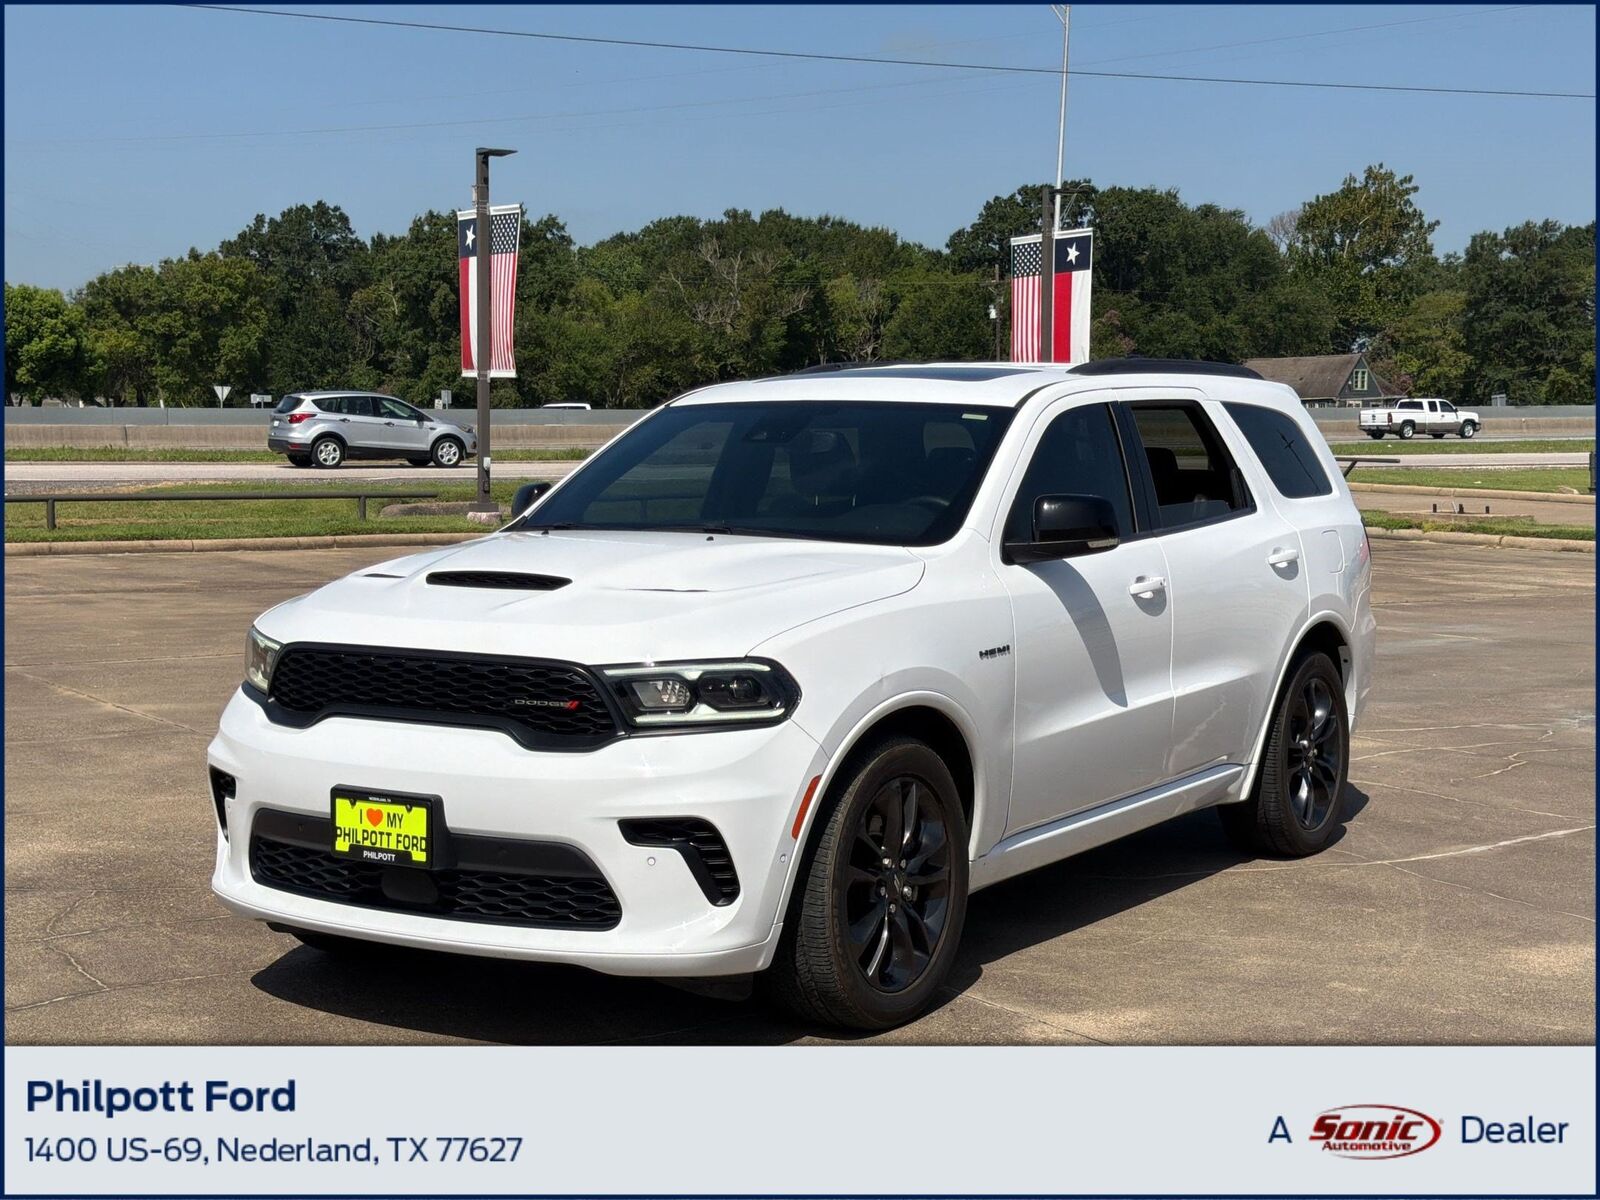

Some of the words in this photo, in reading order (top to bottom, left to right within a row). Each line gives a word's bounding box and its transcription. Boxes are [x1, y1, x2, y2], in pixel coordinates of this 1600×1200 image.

[979, 644, 1010, 658] HEMI
[515, 699, 569, 708] DODGE
[359, 808, 363, 825] I
[386, 812, 404, 828] MY
[335, 826, 392, 848] PHILPOTT
[396, 833, 427, 852] FORD
[363, 850, 396, 862] PHILPOTT
